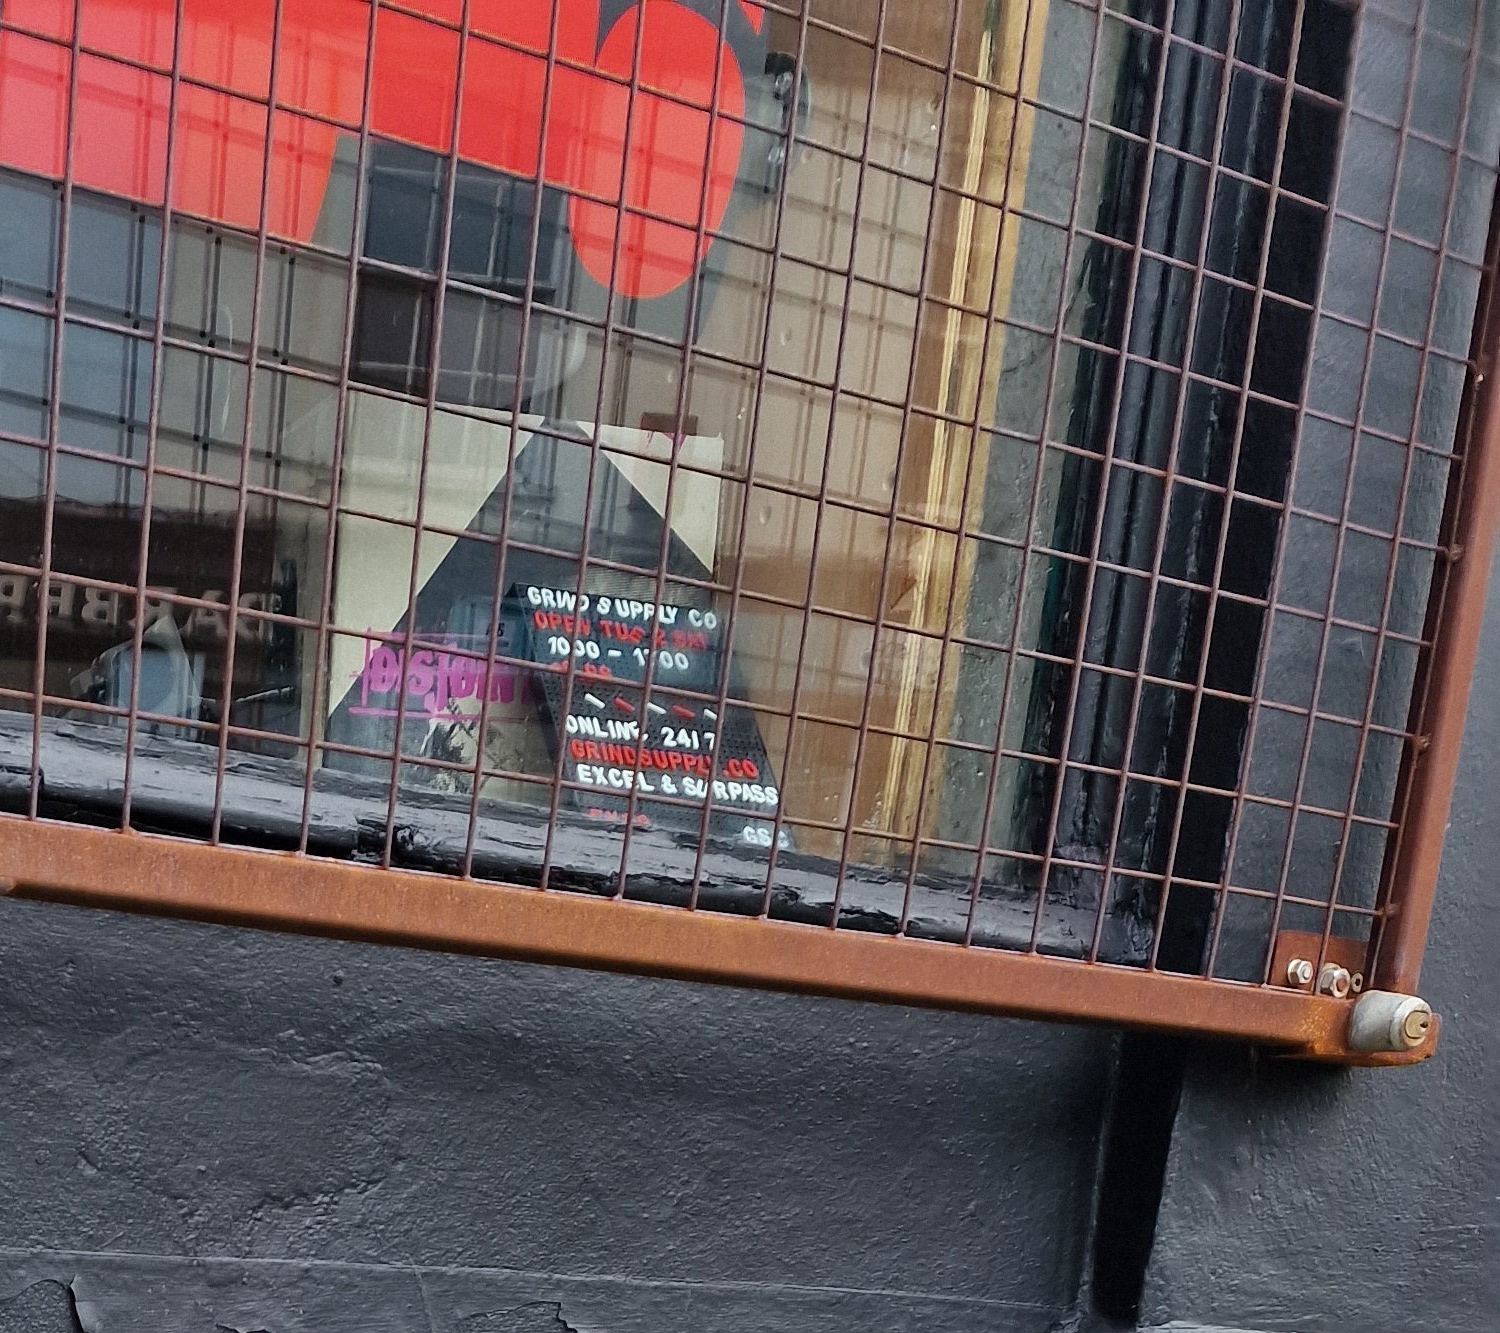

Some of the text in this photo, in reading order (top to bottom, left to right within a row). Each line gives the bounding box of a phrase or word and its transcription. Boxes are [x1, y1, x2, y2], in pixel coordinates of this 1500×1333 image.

[527, 586, 717, 629] GRIND SUPPLY CO
[533, 610, 591, 636] OPEN
[566, 715, 649, 742] ONLINE
[576, 764, 779, 805] EXCEL & SURPASS
